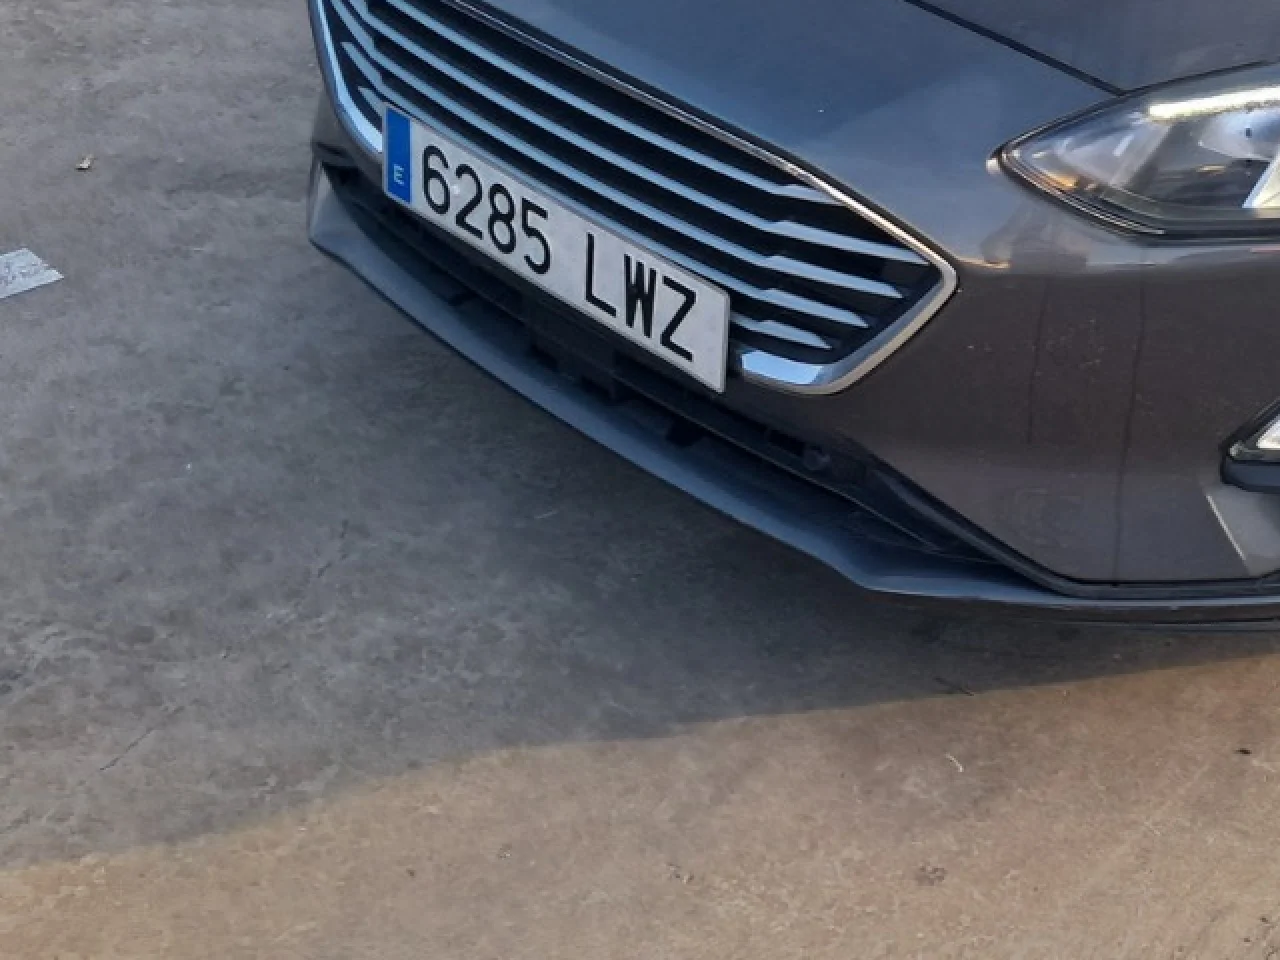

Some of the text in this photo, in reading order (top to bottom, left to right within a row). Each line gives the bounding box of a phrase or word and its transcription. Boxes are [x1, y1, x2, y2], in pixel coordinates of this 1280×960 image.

[393, 164, 405, 186] E
[421, 145, 697, 363] 6285 LWZ
